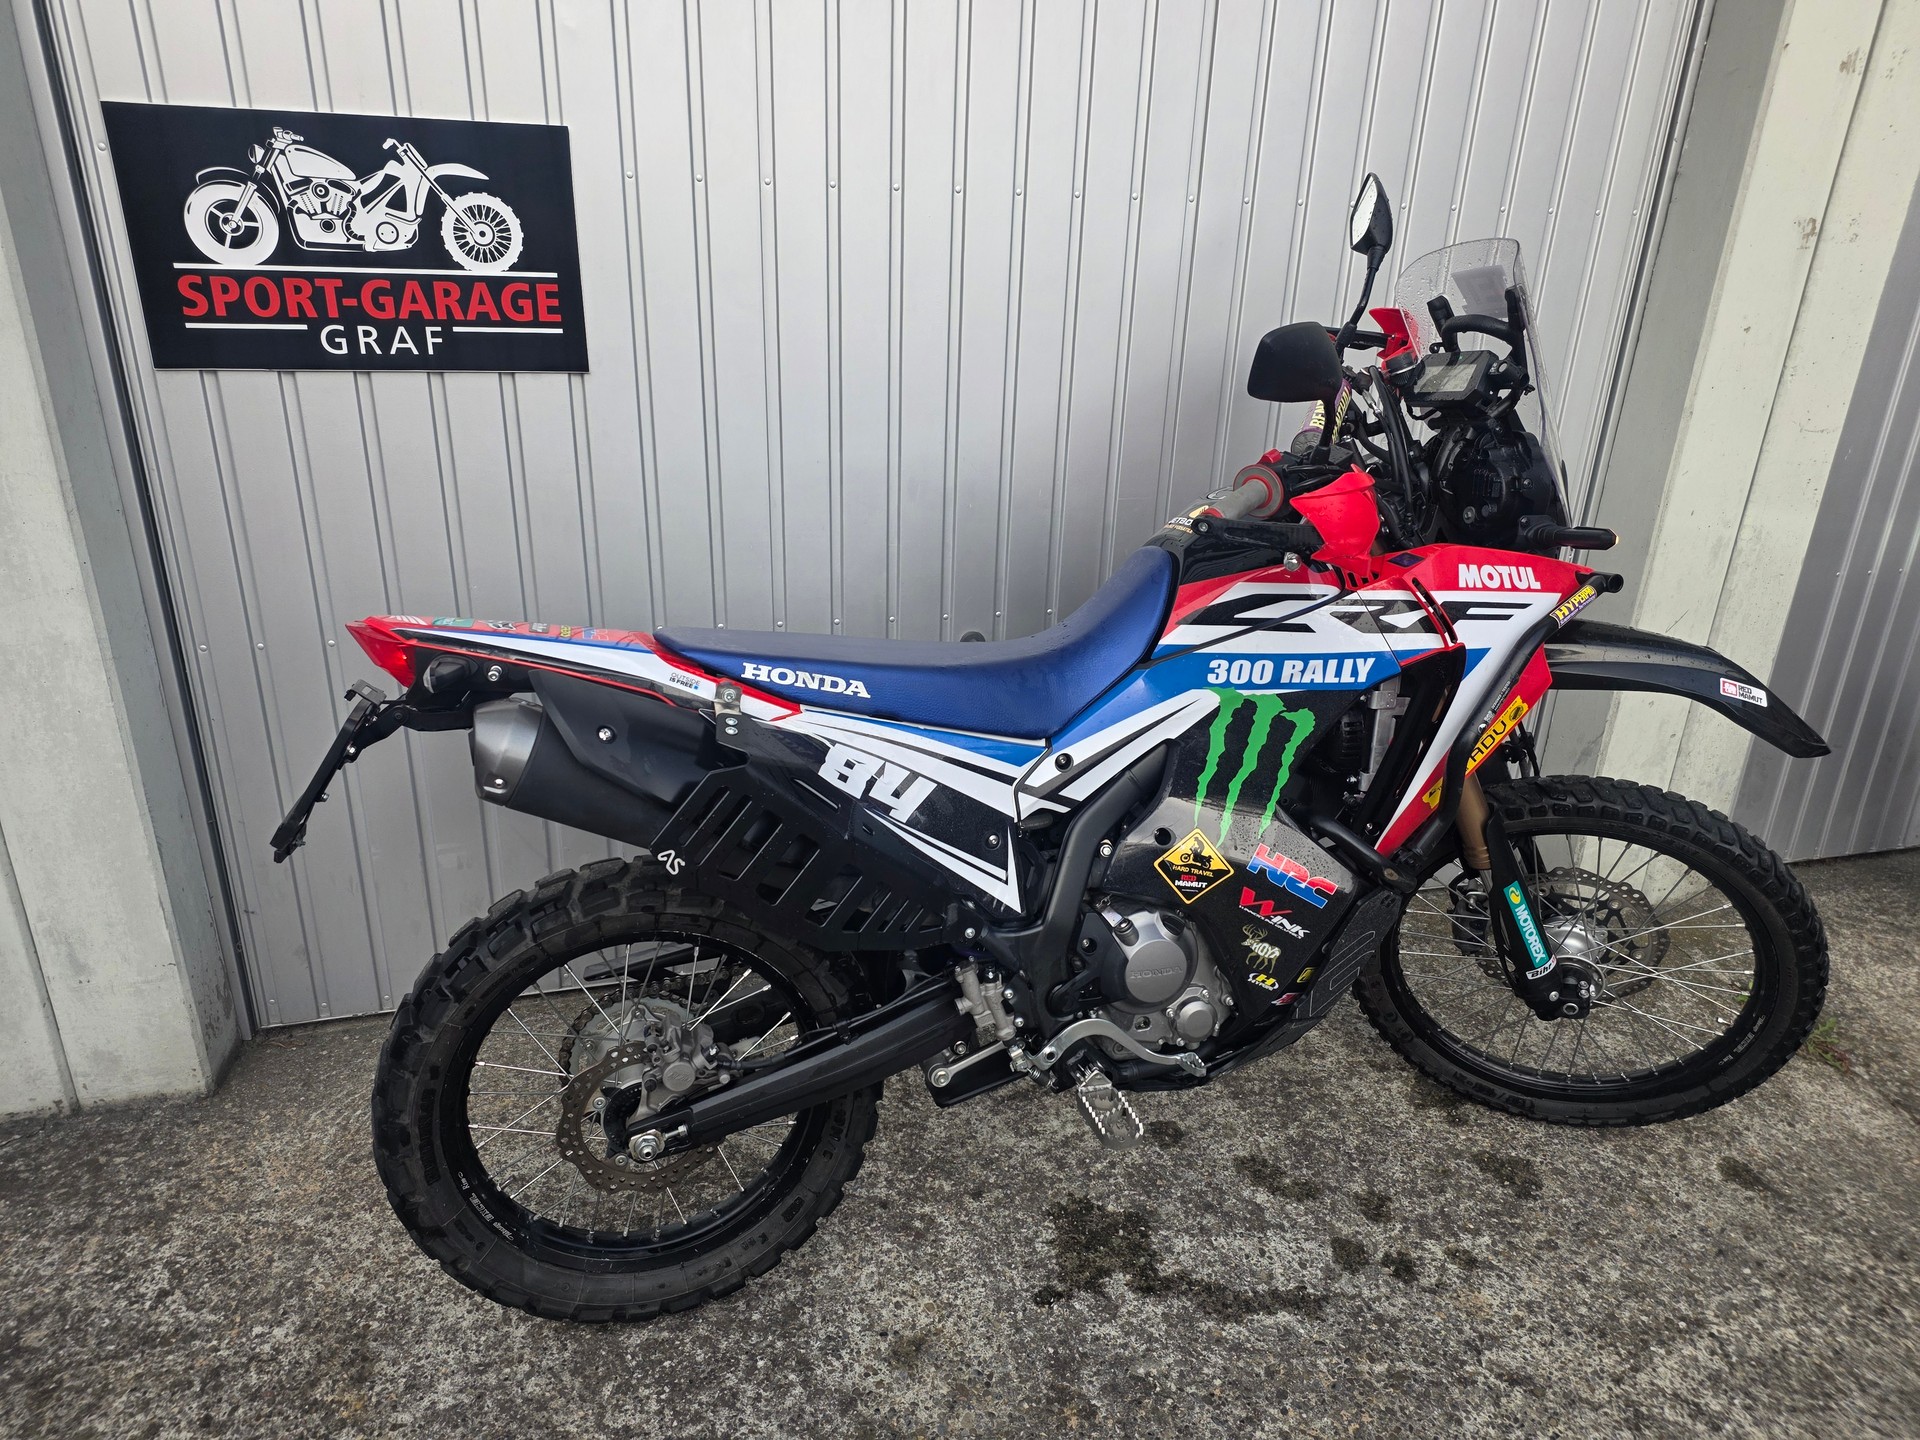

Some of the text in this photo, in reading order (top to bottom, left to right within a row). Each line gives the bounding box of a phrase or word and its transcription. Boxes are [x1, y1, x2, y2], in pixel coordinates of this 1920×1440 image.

[177, 275, 563, 323] SPORT-GARAGE
[320, 325, 443, 356] GRAF
[1458, 564, 1541, 590] MOTUL
[670, 671, 701, 686] OUTSIDE
[740, 662, 872, 699] HONDA
[1206, 657, 1376, 685] 300 RALLY
[1470, 719, 1507, 763] ADV
[1172, 865, 1214, 878] HARD TRAVEL
[1174, 880, 1207, 888] MAMUT
[1246, 843, 1339, 909] HRC
[1514, 904, 1546, 964] MOTOREX
[1129, 966, 1183, 979] HONDA
[1529, 962, 1553, 979] Bihr
